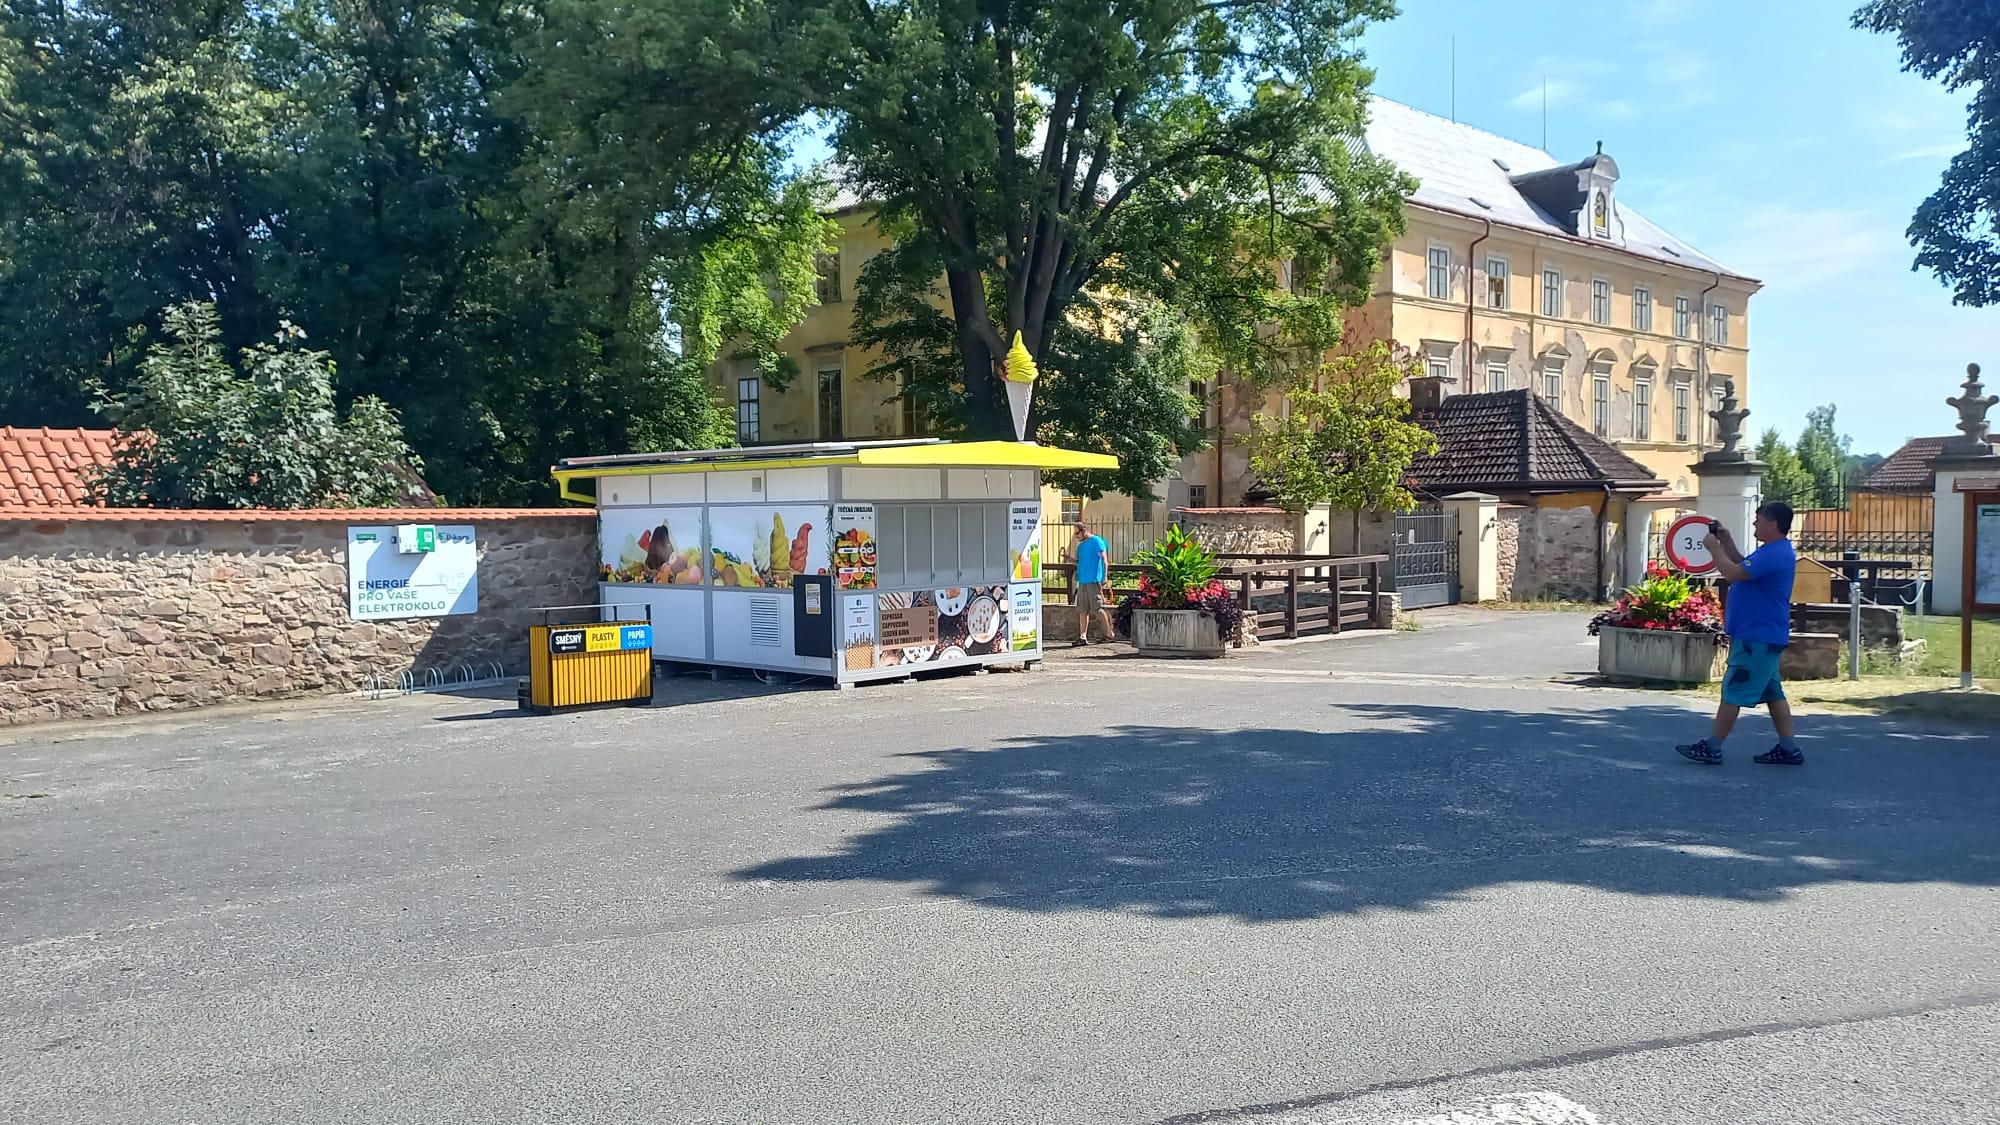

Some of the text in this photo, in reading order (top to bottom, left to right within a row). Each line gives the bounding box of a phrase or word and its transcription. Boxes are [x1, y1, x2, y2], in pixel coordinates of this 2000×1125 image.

[358, 579, 410, 589] ENERGIE
[358, 589, 418, 601] PRO VAŠE
[358, 602, 446, 613] ELEKTROKOLO
[556, 633, 582, 645] SMĚSNÝ
[592, 632, 614, 642] PLASTY
[628, 630, 645, 639] PAPÍR
